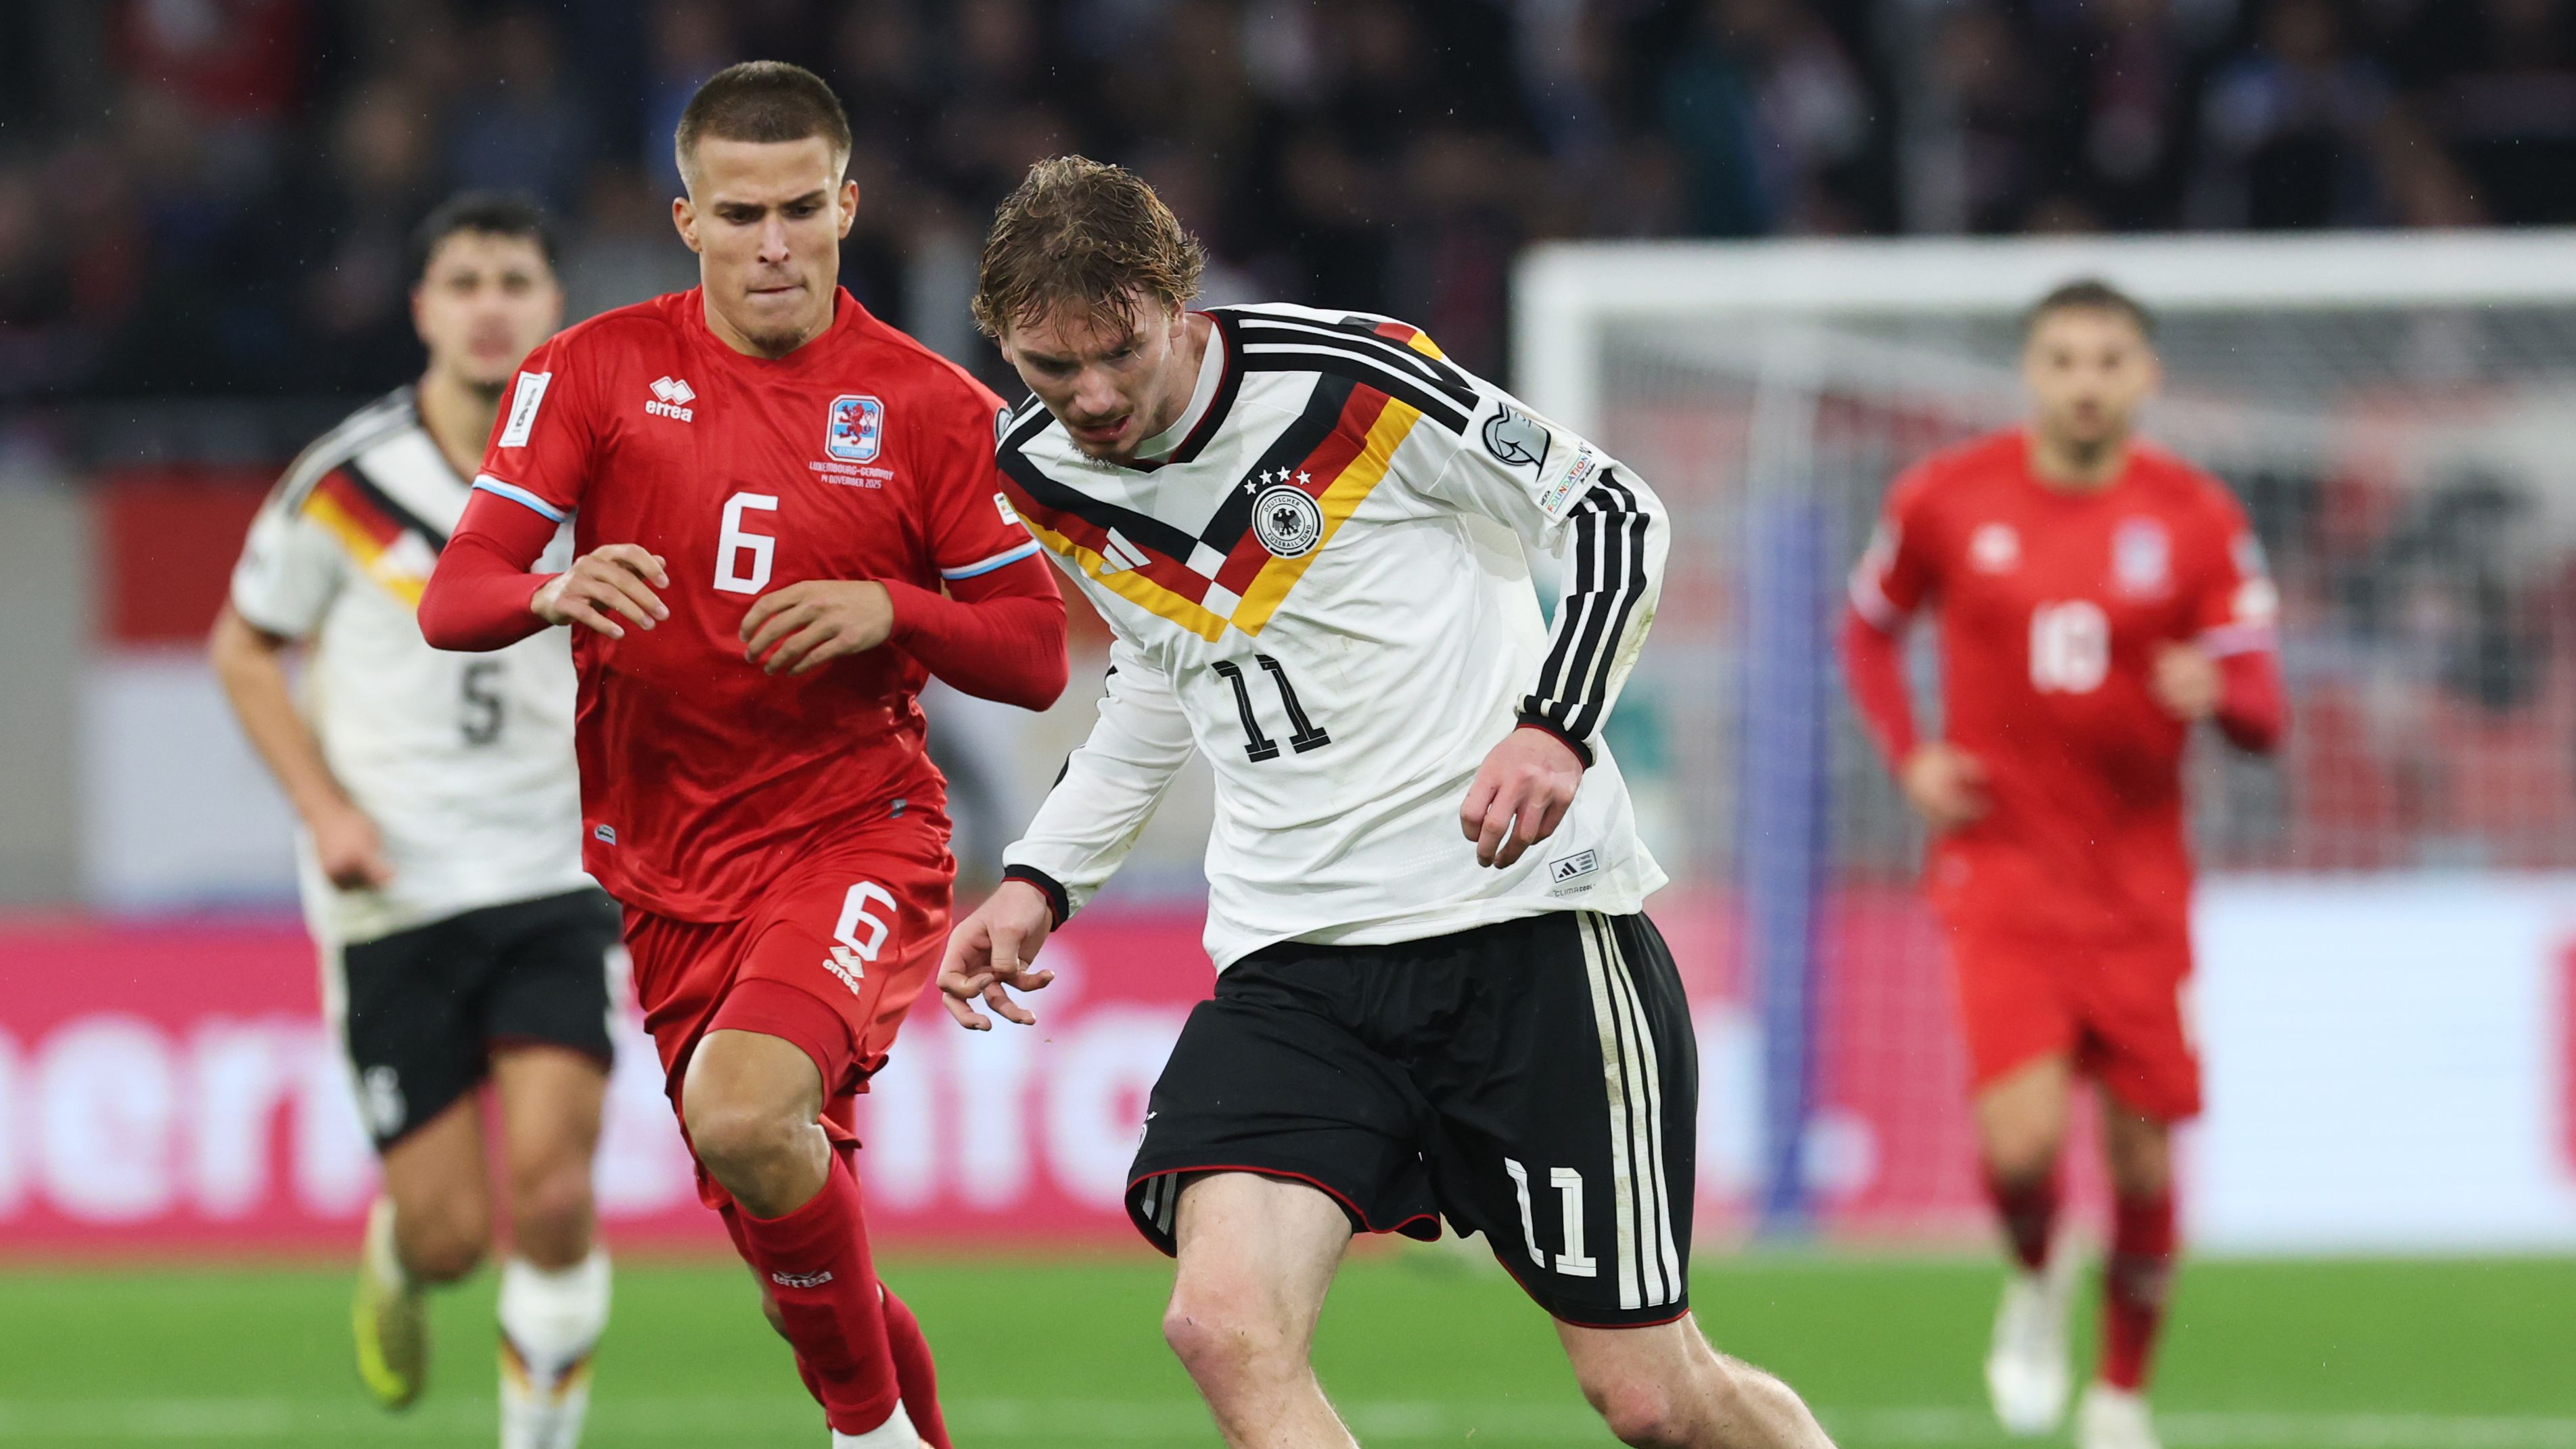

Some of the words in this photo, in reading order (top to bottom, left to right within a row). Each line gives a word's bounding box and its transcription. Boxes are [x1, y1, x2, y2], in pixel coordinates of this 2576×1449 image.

[645, 400, 693, 423] errea
[865, 478, 882, 489] 2025
[1264, 497, 1301, 513] DEUTSCHER
[1539, 490, 1551, 506] UEFA
[1546, 455, 1588, 513] FOUNDATION
[712, 491, 779, 595] 6
[1266, 524, 1312, 547] FUSSBALL-BUND
[461, 659, 506, 747] 5
[1211, 653, 1332, 763] 11
[833, 880, 898, 962] 6
[822, 959, 860, 996] errea
[1504, 1156, 1597, 1277] 11
